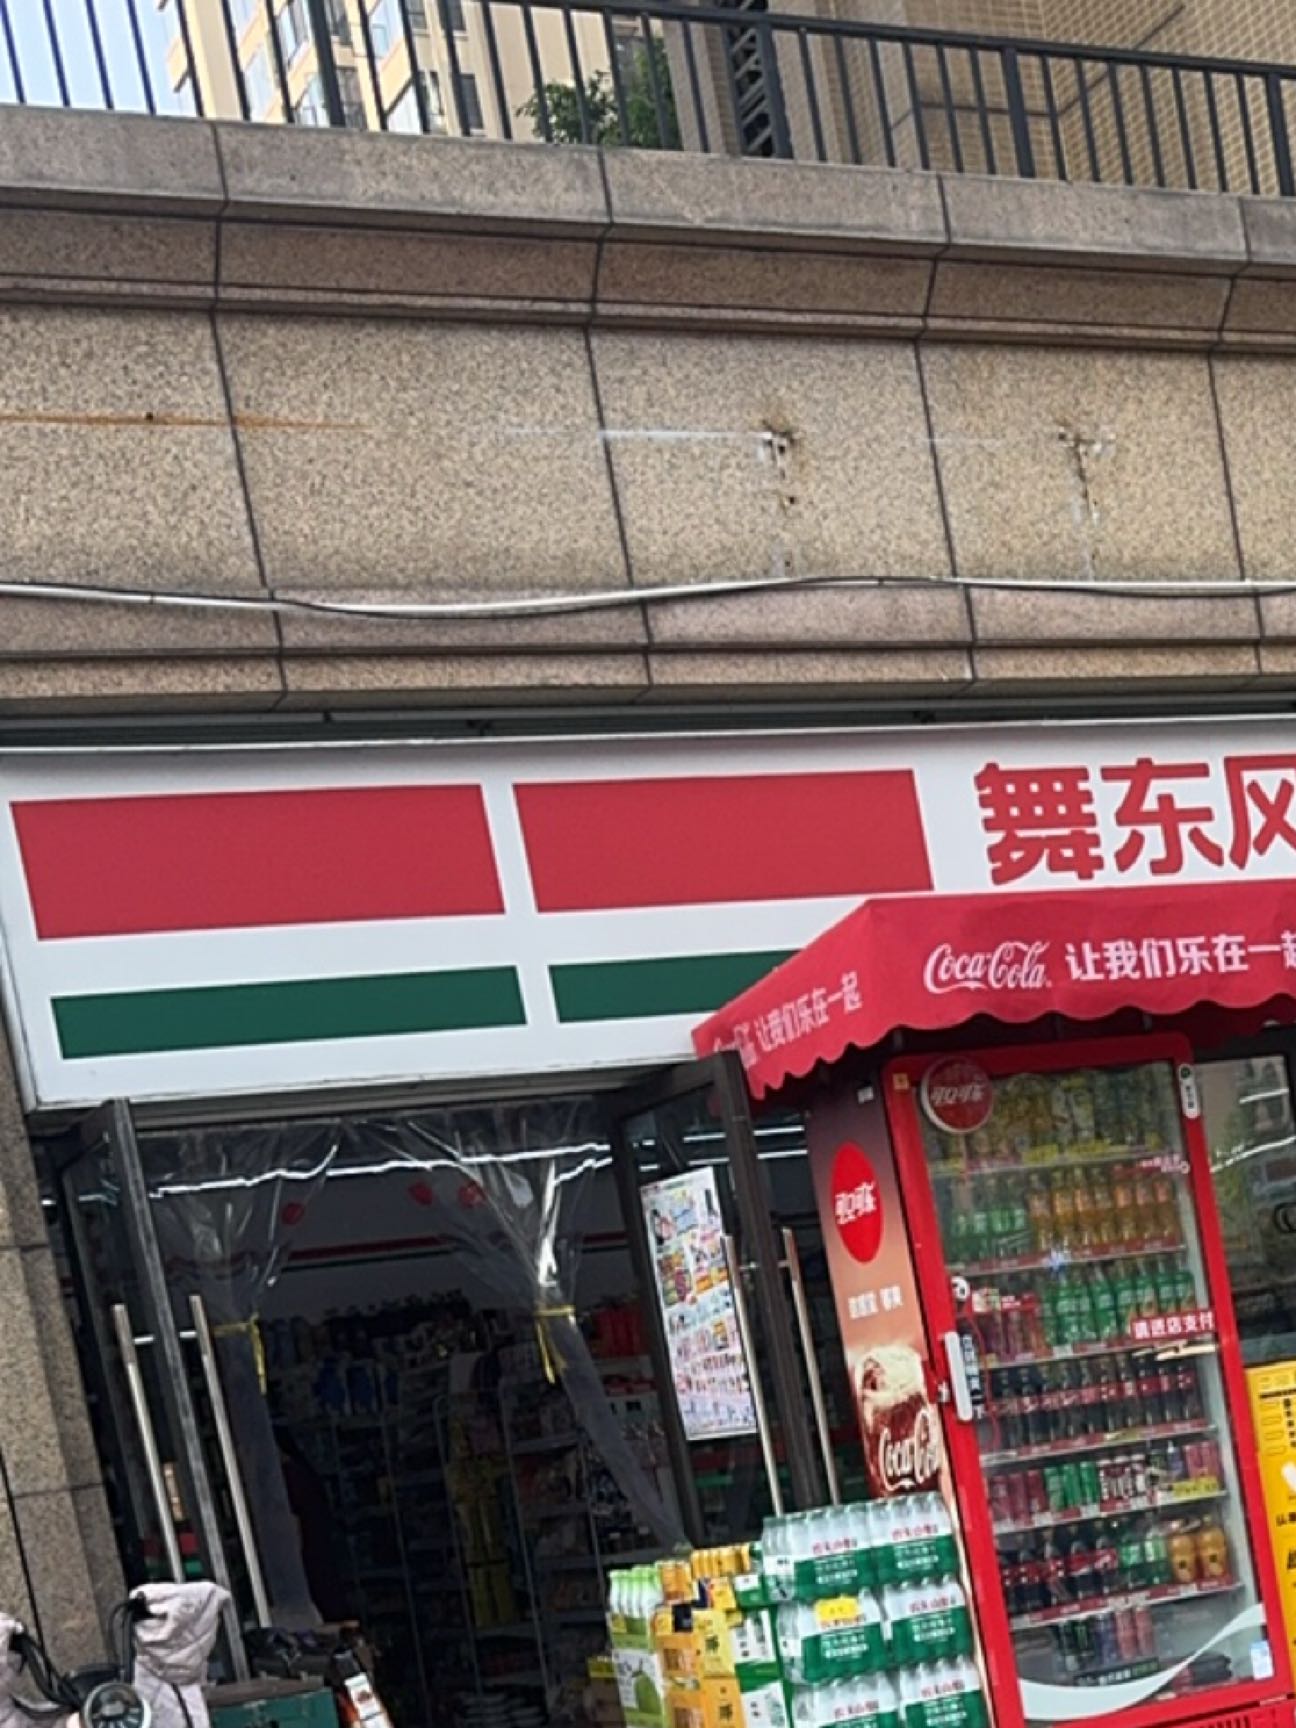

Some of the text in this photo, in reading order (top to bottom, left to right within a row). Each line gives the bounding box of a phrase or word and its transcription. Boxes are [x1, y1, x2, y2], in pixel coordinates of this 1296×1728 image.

[923, 940, 1052, 995] Coca-Cola
[753, 971, 863, 1052] 让我们乐在一起
